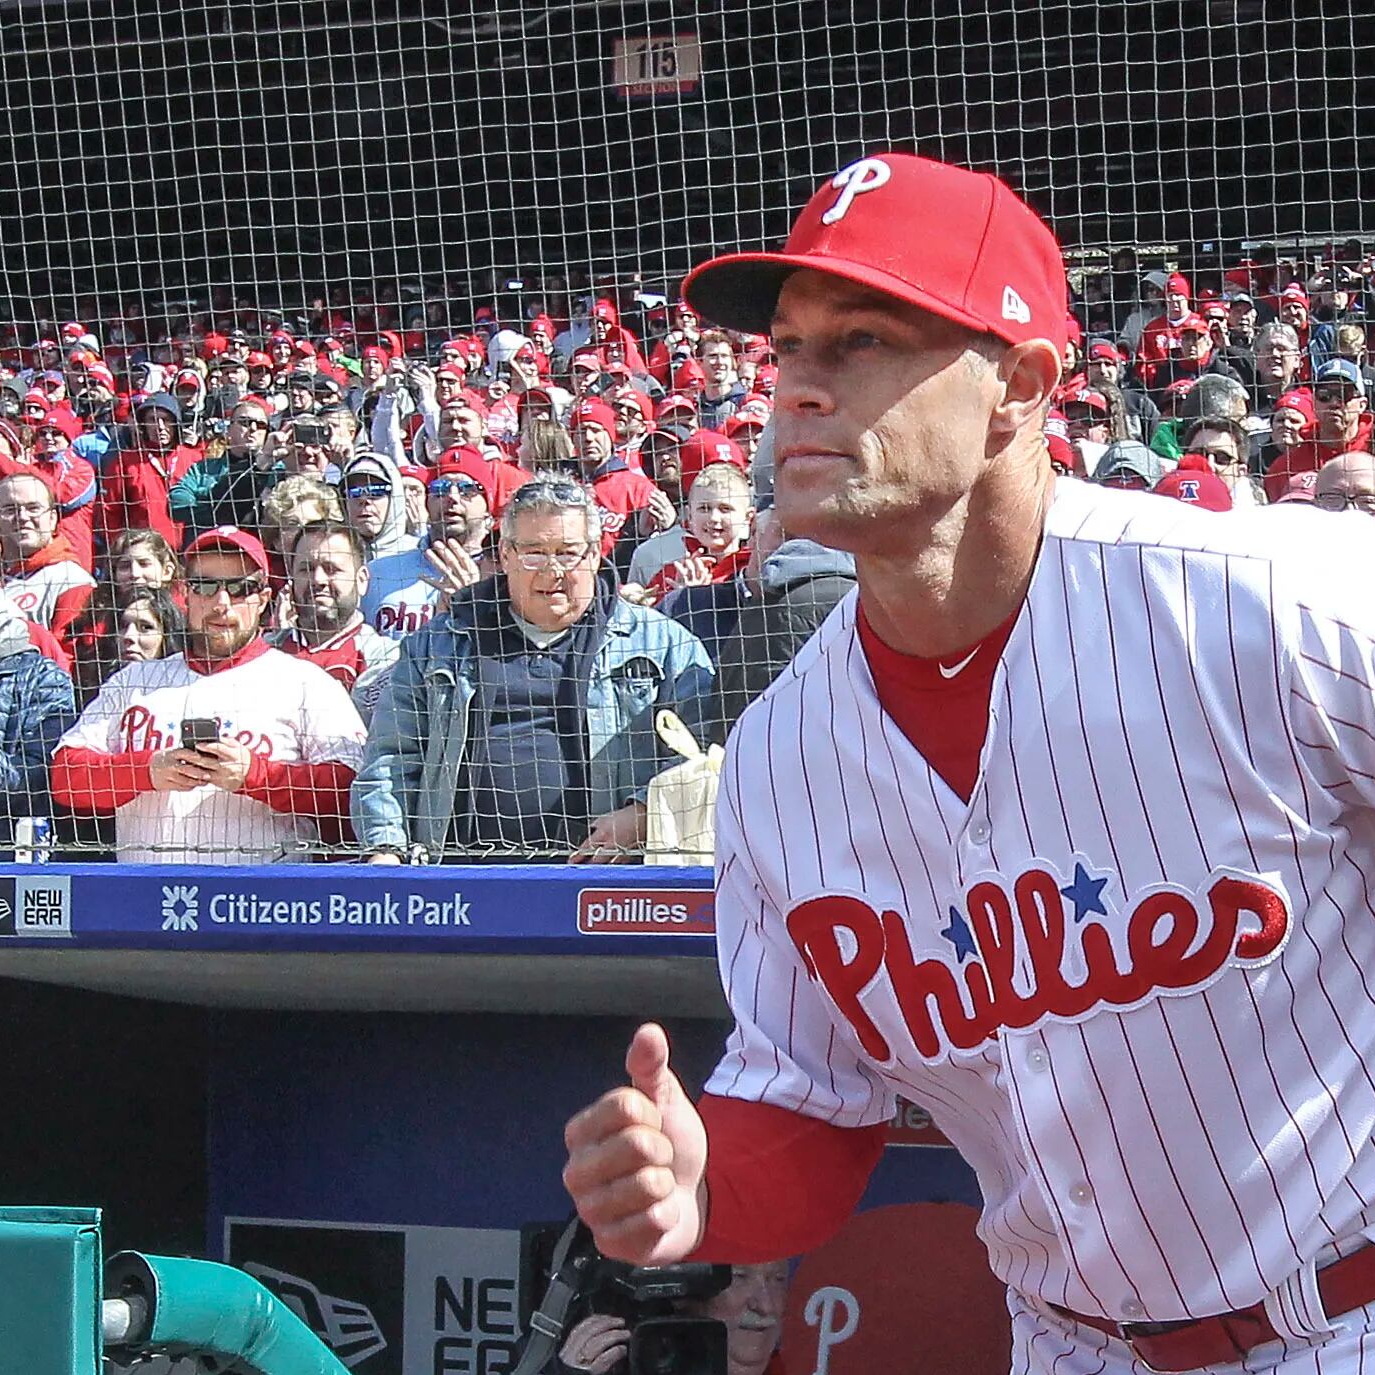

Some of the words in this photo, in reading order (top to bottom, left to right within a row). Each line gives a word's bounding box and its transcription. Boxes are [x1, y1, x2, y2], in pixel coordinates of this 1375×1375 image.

[638, 41, 677, 79] 115
[822, 158, 892, 225] P
[23, 889, 63, 906] NEW
[23, 907, 63, 926] ERA
[209, 893, 322, 923] Citizens
[329, 893, 401, 923] Bank
[407, 893, 471, 924] Park
[785, 867, 1290, 1062] Phillies
[433, 1275, 518, 1335] NE
